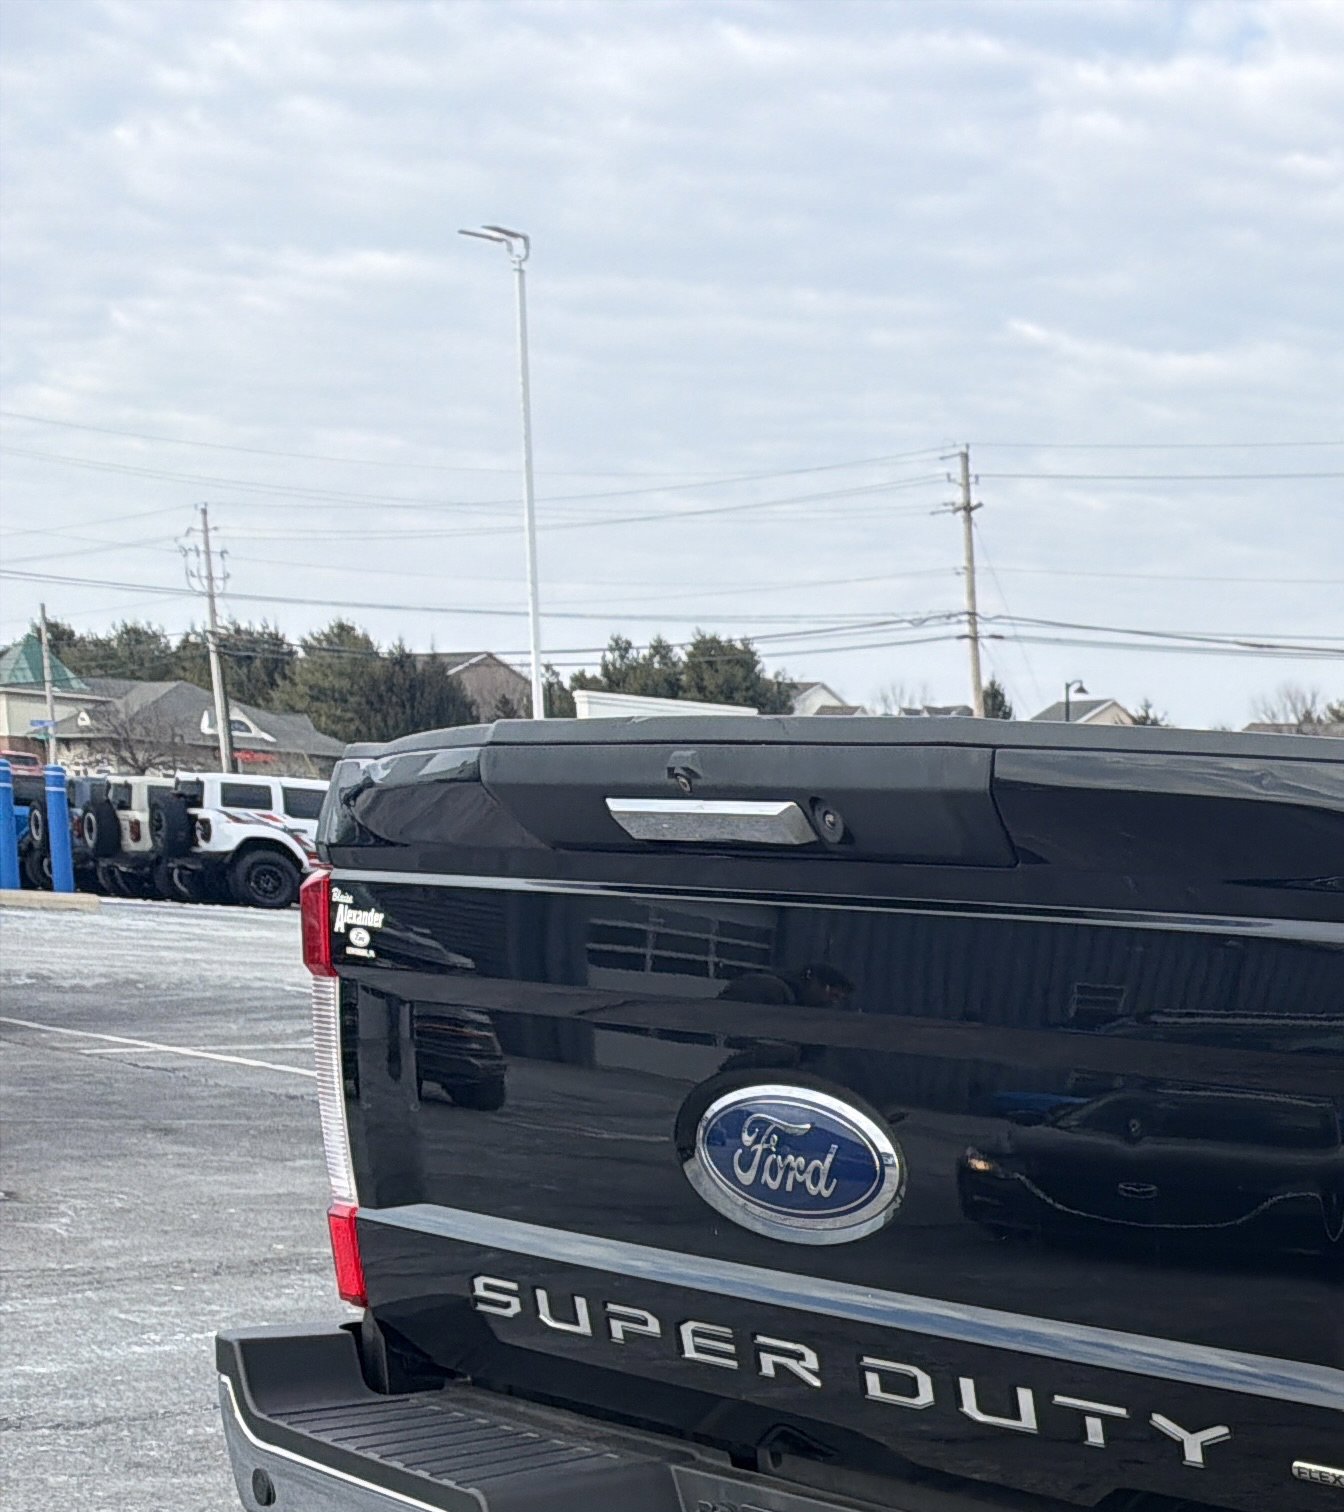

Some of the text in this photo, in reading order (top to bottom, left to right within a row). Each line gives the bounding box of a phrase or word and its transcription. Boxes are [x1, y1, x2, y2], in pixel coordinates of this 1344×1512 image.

[334, 904, 384, 932] Alexander
[733, 1113, 839, 1198] Ford
[472, 1274, 1232, 1468] SUPER DUTY
[1296, 1465, 1344, 1487] FLEX
